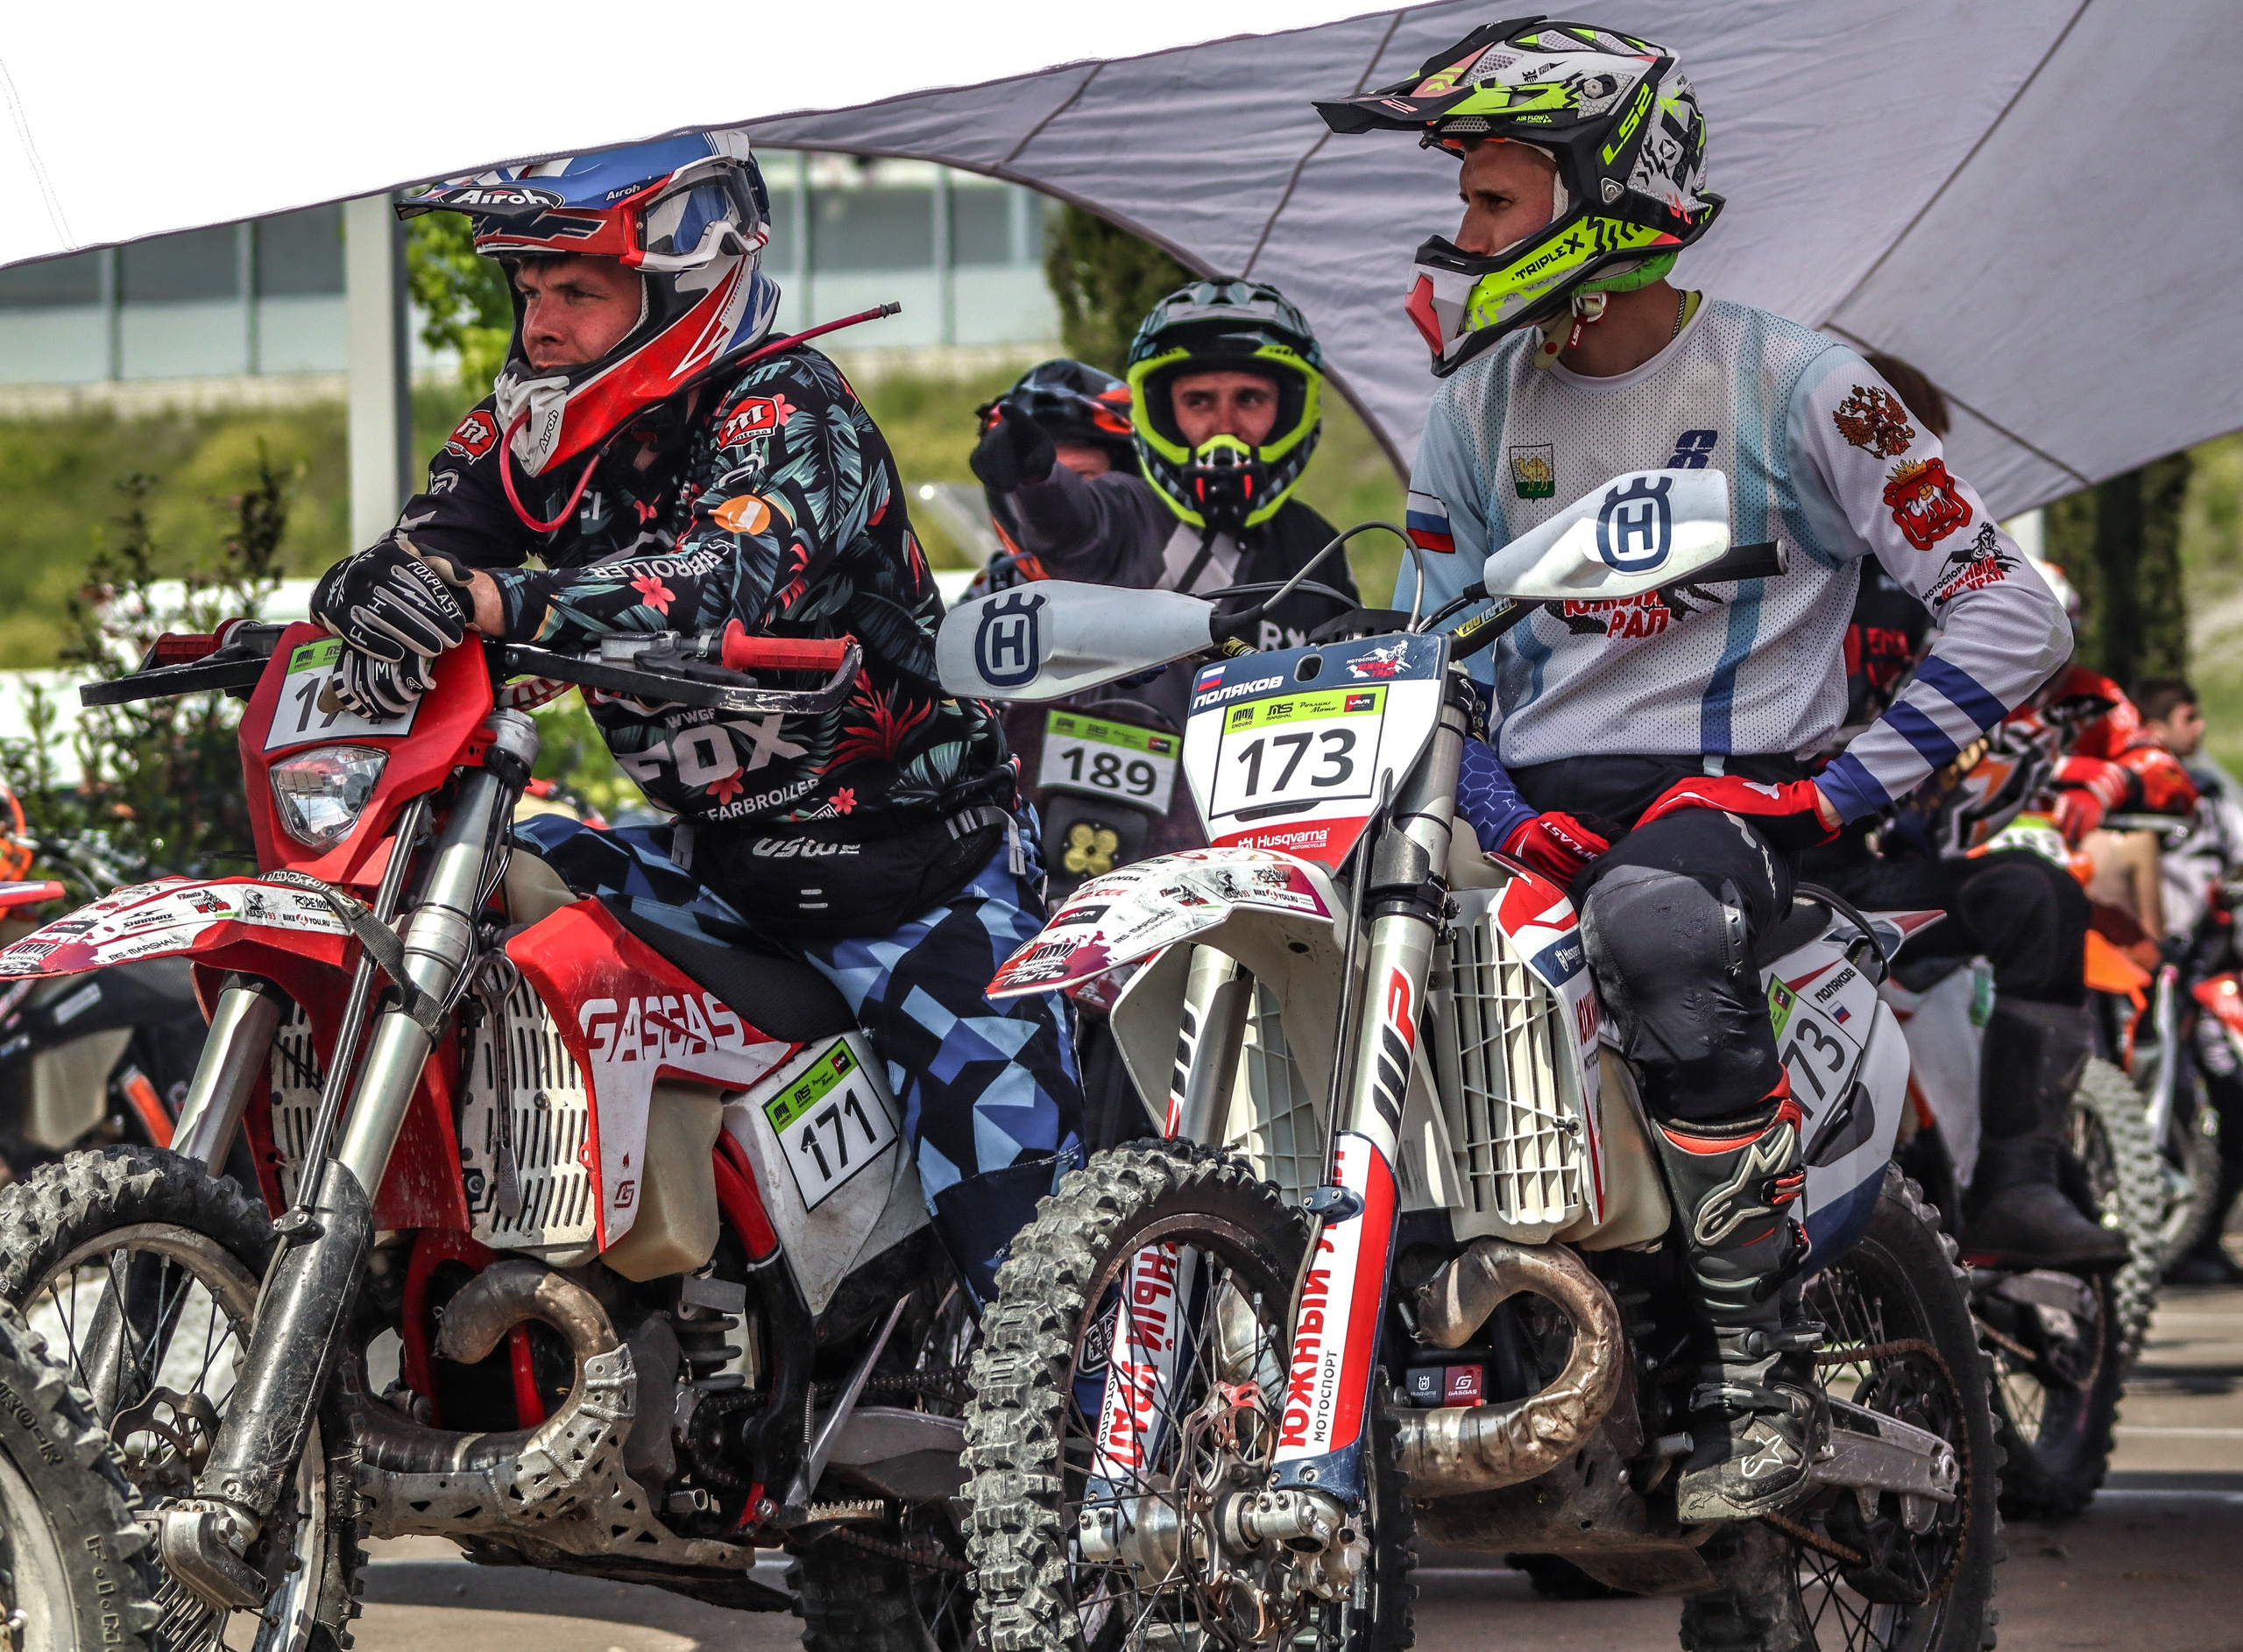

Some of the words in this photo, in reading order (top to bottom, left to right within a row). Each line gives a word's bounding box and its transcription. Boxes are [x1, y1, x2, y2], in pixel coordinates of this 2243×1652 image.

[1602, 82, 1653, 166] LS2
[450, 189, 553, 205] Airoh
[605, 184, 640, 202] Airoh
[1572, 324, 1581, 346] LS2
[540, 409, 559, 455] Airoh
[407, 561, 462, 620] FOXPLAST
[1921, 563, 1967, 602] МОТОСПОРТ
[1941, 554, 1998, 602] ЮЖНЫЙ
[1966, 568, 2006, 591] УРАЛ
[1607, 608, 1670, 639] РАЛ
[1193, 675, 1284, 710] ПОЛЯКОВ
[1232, 720, 1252, 730] ENDURO
[614, 713, 809, 787] FOX
[1061, 746, 1157, 796] 189
[1237, 728, 1356, 797] 173
[1257, 828, 1327, 850] Husqvarna
[1540, 821, 1598, 861] PLAST
[1814, 967, 1857, 1004] ПОЛЯКОВ
[578, 992, 745, 1063] GASGAS
[800, 1087, 879, 1183] 171
[1125, 1242, 1176, 1352] НЫЙ
[1278, 1268, 1331, 1448] ЮЖНЫЙ
[1314, 1350, 1338, 1443] МОТОСПОРТ
